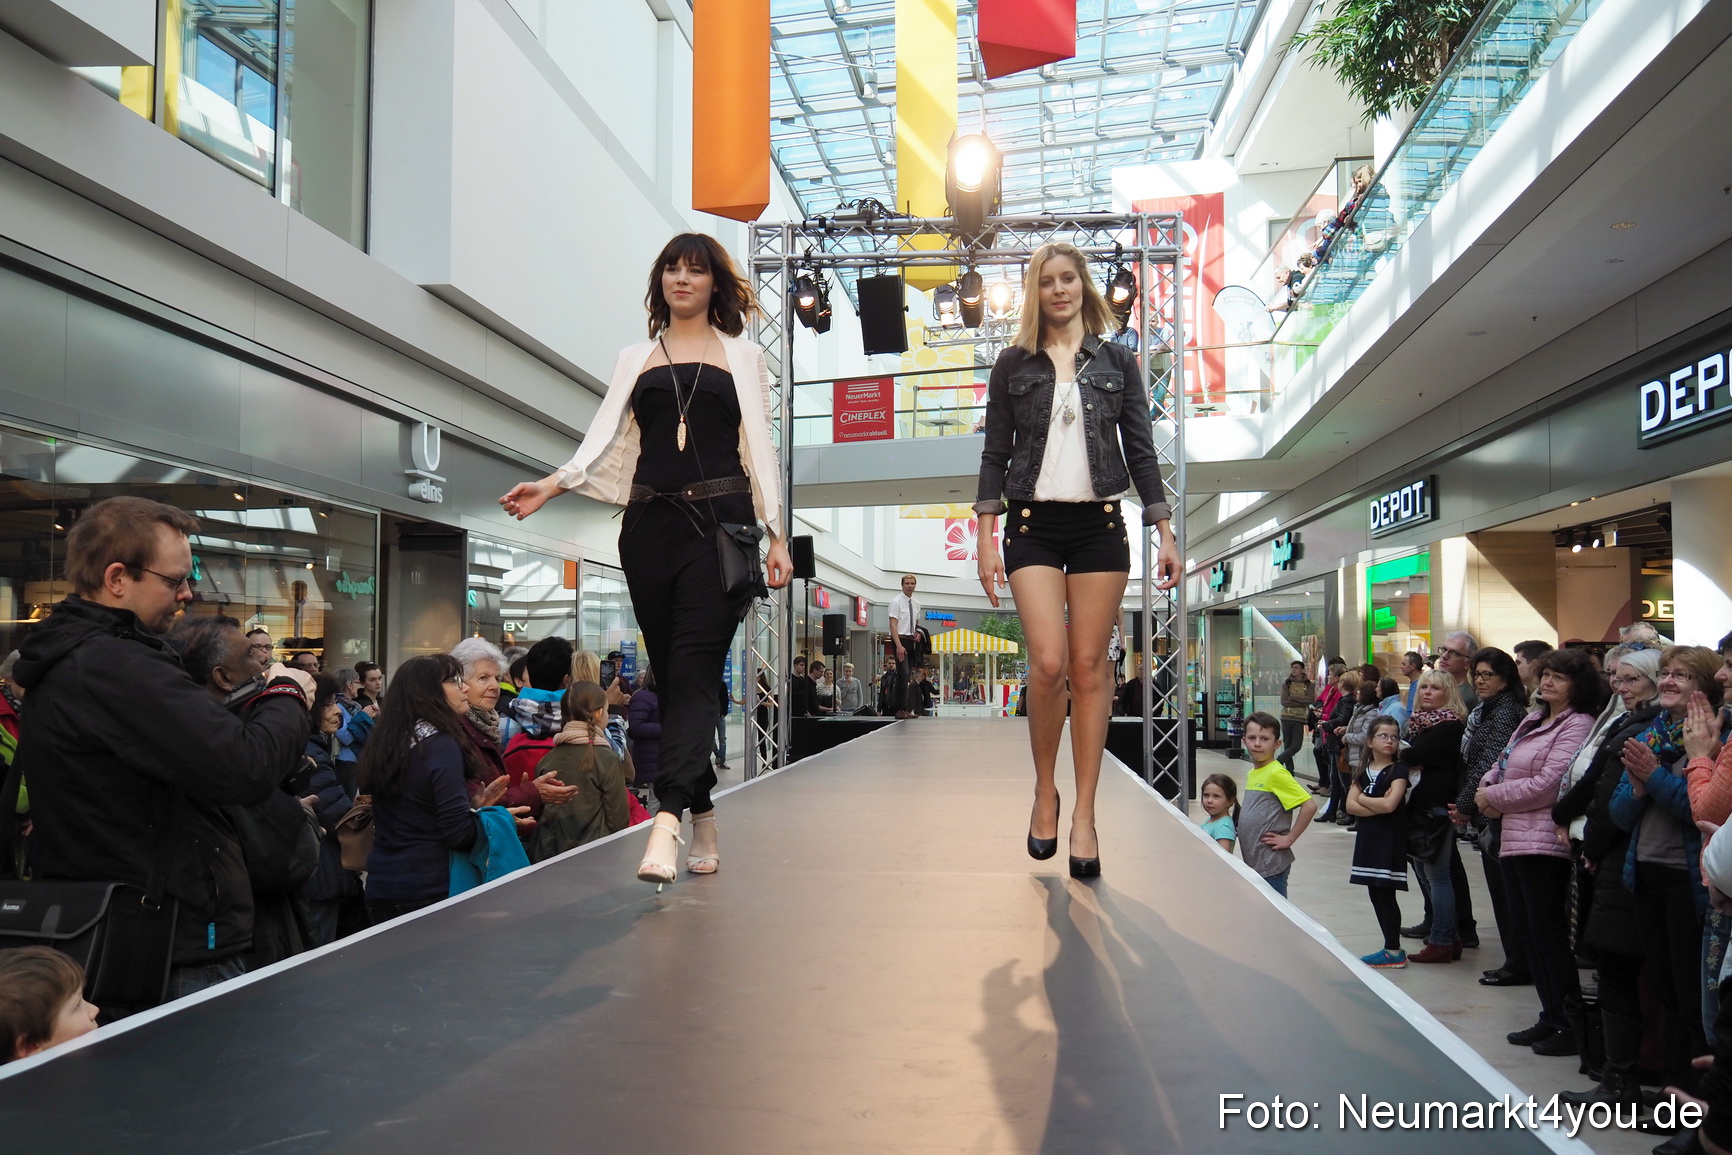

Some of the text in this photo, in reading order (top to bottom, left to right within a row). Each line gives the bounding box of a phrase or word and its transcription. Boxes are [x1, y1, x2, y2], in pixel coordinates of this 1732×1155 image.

[846, 392, 881, 400] NeuerMarkt
[1640, 348, 1732, 432] DEP
[840, 411, 886, 423] CINEPLEX
[416, 422, 441, 472] U
[1369, 480, 1424, 530] DEPOT
